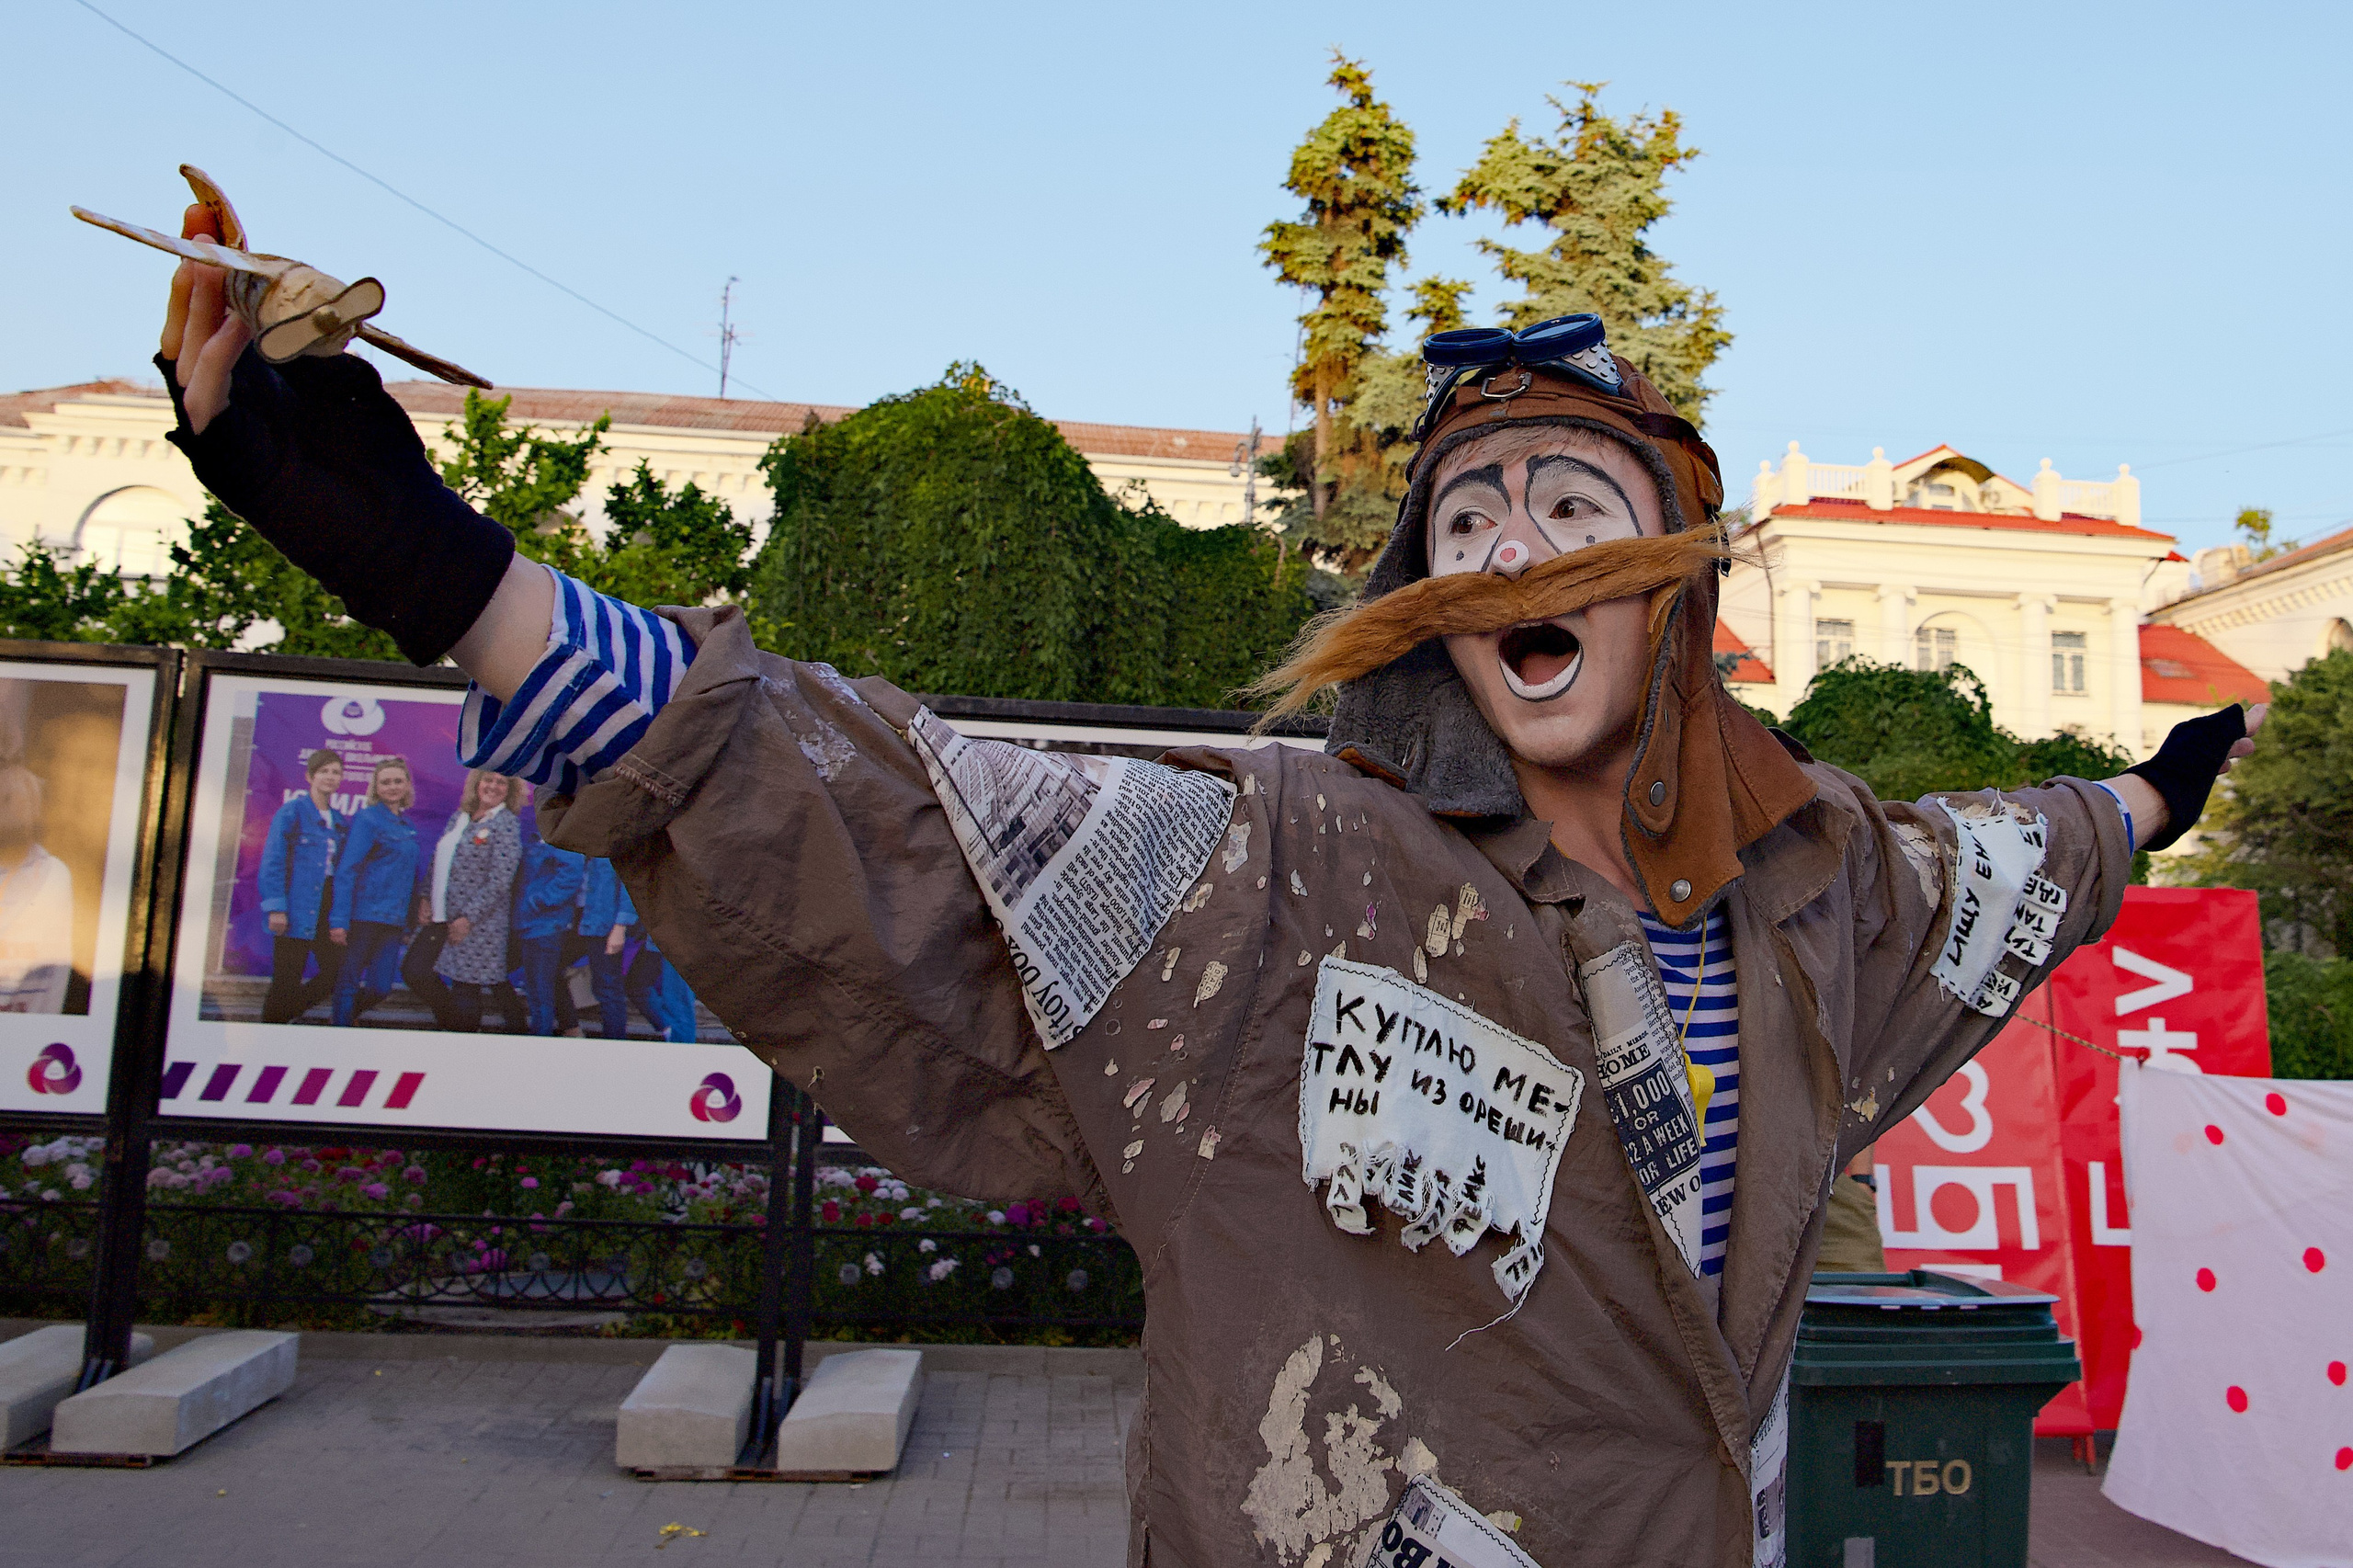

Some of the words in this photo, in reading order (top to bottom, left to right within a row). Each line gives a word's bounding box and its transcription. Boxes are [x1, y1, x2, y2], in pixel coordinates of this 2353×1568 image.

[1115, 783, 1133, 796] and
[1118, 777, 1132, 788] Its
[1111, 796, 1132, 815] Tele-
[1115, 789, 1137, 807] Hub-
[1146, 795, 1158, 806] in
[1153, 790, 1164, 801] in
[1160, 799, 1176, 813] feet
[1165, 790, 1178, 801] up
[1201, 793, 1220, 811] orbit
[1131, 802, 1144, 814] to
[1131, 792, 1167, 833] construction
[1154, 801, 1173, 827] launch
[1170, 810, 1181, 821] 21
[1172, 799, 1191, 823] folded
[1195, 803, 1210, 820] that
[1098, 818, 1108, 828] as
[1102, 808, 1135, 843] including
[1108, 805, 1142, 837] asteroids.
[1128, 809, 1151, 833] Space
[1168, 824, 1179, 837] for
[1176, 817, 1198, 843] mirror,
[1187, 820, 1199, 832] be
[1088, 835, 1100, 848] re-
[1092, 826, 1108, 845] color
[1106, 826, 1131, 854] objects
[1162, 832, 1180, 854] under
[1194, 829, 1205, 839] to
[1199, 836, 1213, 851] has
[1080, 844, 1092, 856] its
[1095, 846, 1109, 861] the
[1103, 838, 1132, 871] produce
[1130, 837, 1148, 861] move,
[1155, 839, 1176, 865] NASA's
[1174, 834, 1204, 866] scheduled
[1176, 851, 1187, 862] is
[1190, 839, 1210, 858] main
[1064, 860, 1080, 877] will
[1073, 852, 1090, 870] each
[1089, 854, 1104, 869] over
[1127, 853, 1149, 882] celestial
[1151, 849, 1169, 871] James
[1173, 859, 1196, 881] scope,
[1183, 859, 1202, 875] ble,
[1058, 867, 1086, 900] Synoptic
[1085, 868, 1096, 879] of
[1100, 869, 1117, 885] sky
[1104, 856, 1133, 889] together,
[1125, 868, 1141, 883] will
[1149, 863, 1184, 898] potentially
[1165, 869, 1180, 885] The
[1050, 878, 1063, 892] in-
[1077, 875, 1101, 902] (LSST)
[1090, 873, 1115, 900] images
[1110, 882, 1131, 905] entire
[1036, 892, 1052, 908] big
[1047, 889, 1081, 927] telescopes.
[1108, 896, 1128, 918] 1,000
[1125, 885, 1146, 909] Taken
[1158, 889, 1177, 907] they
[1046, 903, 1056, 914] as
[1062, 891, 1101, 937] ground-based
[1081, 897, 1102, 920] Large
[1096, 899, 1127, 935] Telescope
[1127, 903, 1141, 918] the
[1025, 910, 1045, 932] giant
[1029, 900, 1074, 952] light-collecting
[1050, 911, 1070, 933] times
[1097, 918, 1110, 934] the
[1121, 915, 1142, 937] about
[1136, 916, 1147, 927] in
[1947, 887, 1980, 966] ИЩУ
[1018, 919, 1048, 952] powerful
[1039, 930, 1053, 946] two
[1063, 929, 1079, 946] four
[1073, 921, 1098, 950] existing
[1073, 941, 1084, 952] to
[1122, 932, 1145, 959] Survey
[1135, 934, 1151, 950] take
[1042, 949, 1060, 968] more
[1049, 942, 1078, 975] including
[1066, 949, 1083, 967] with
[1078, 948, 1096, 968] three
[1091, 945, 1102, 956] on
[1097, 938, 1122, 968] Another
[1107, 931, 1138, 967] strument,
[1096, 953, 1115, 974] those
[1054, 965, 1076, 989] larger,
[1078, 962, 1108, 998] telescopes
[1090, 962, 1113, 990] mirrors
[1071, 986, 1085, 1002] even
[1072, 971, 1101, 1006] machines,
[1029, 980, 1074, 1028] toy
[1336, 989, 1476, 1075] КУПЛЮ
[1493, 1065, 1569, 1117] МЕ-
[1602, 1045, 1622, 1059] DAILY
[1626, 1030, 1649, 1047] MIRROR
[1312, 1041, 1392, 1084] ТЛУ
[1411, 1068, 1446, 1105] ИЗ
[1329, 1087, 1379, 1116] НЫ
[1634, 1110, 1660, 1131] OR
[1642, 1135, 1654, 1156] A
[1653, 1112, 1690, 1147] WEEK
[1665, 1137, 1698, 1170] LIFE
[1885, 1459, 1972, 1496] ТБО
